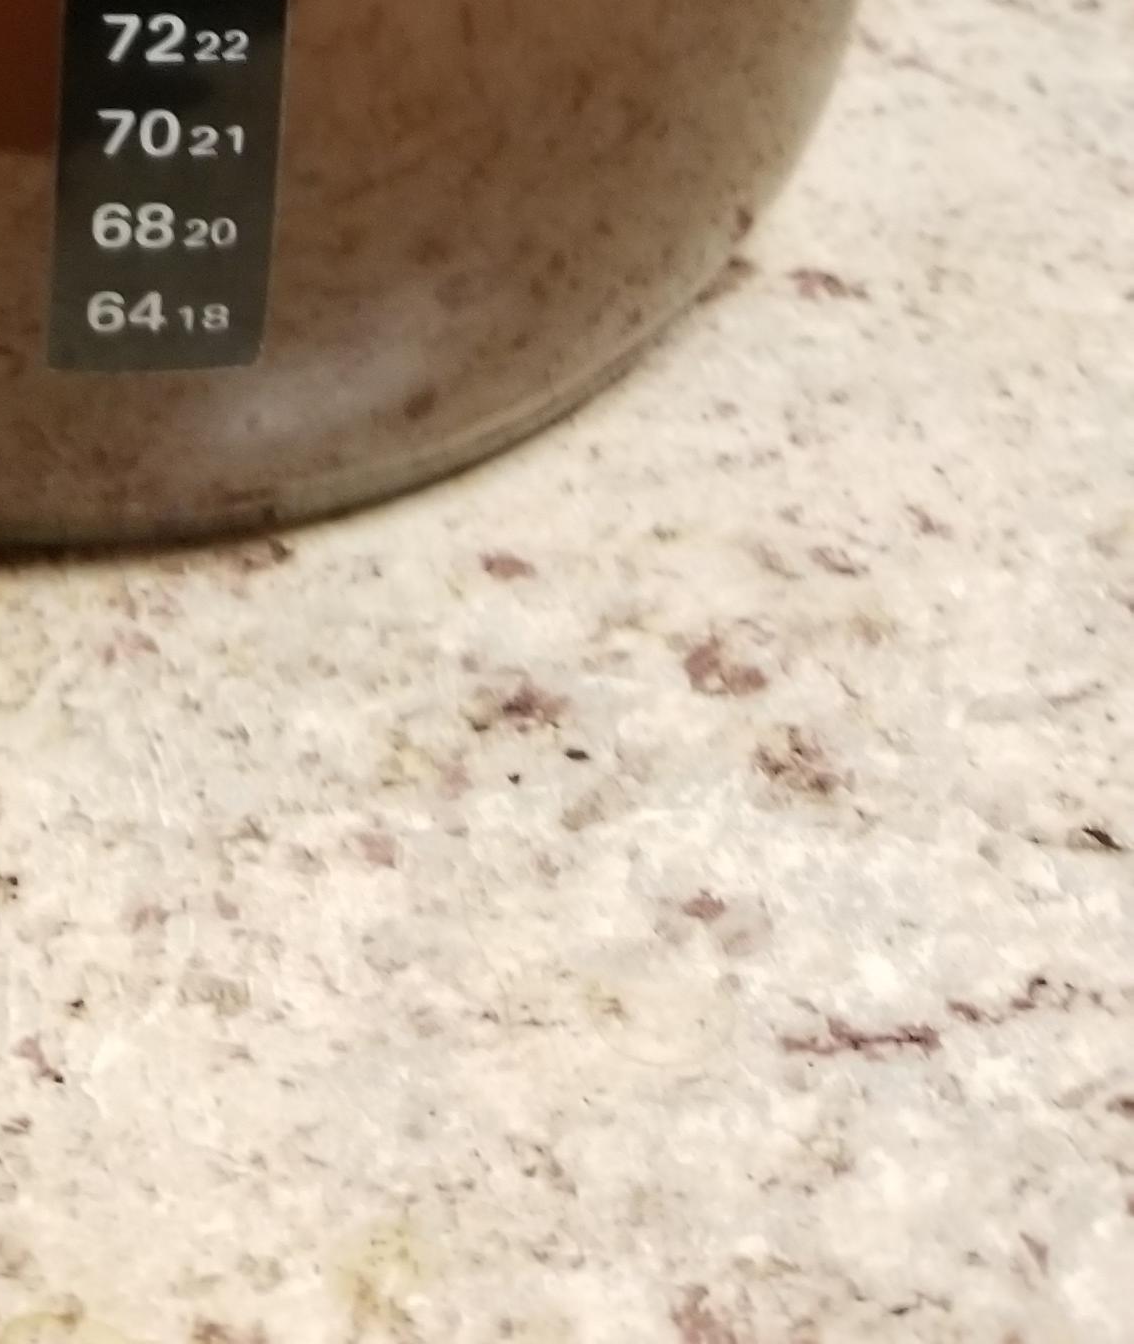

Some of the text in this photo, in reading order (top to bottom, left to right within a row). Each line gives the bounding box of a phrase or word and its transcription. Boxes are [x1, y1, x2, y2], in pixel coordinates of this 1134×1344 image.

[102, 12, 249, 64] 72 22
[96, 108, 245, 158] 70 21
[91, 202, 237, 250] 68 20
[86, 290, 230, 334] 64 18
